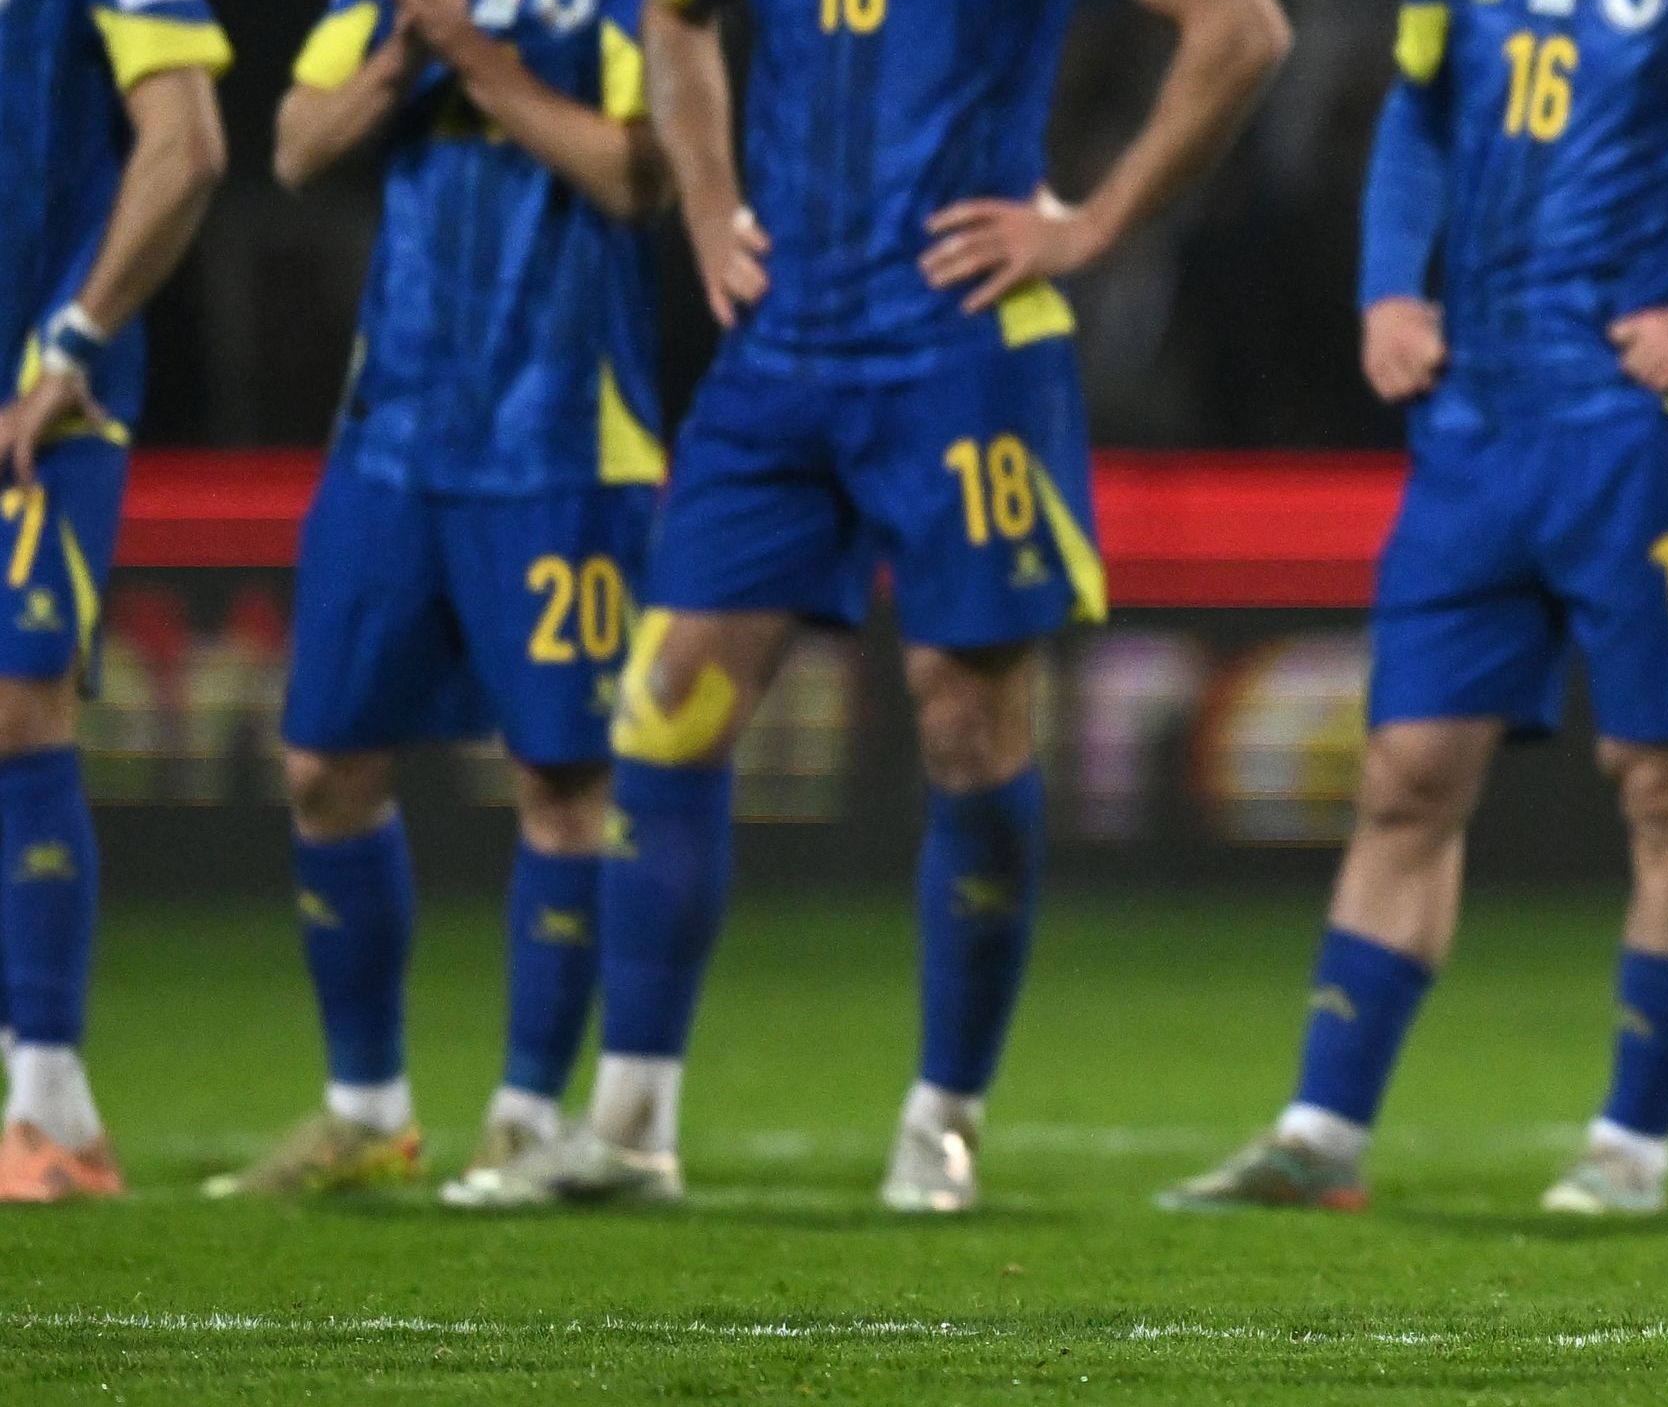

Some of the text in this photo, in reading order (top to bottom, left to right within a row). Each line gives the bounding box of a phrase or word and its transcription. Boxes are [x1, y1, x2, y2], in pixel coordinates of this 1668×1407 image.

[1503, 29, 1581, 142] 16
[944, 433, 1034, 546] 18
[526, 555, 622, 663] 20
